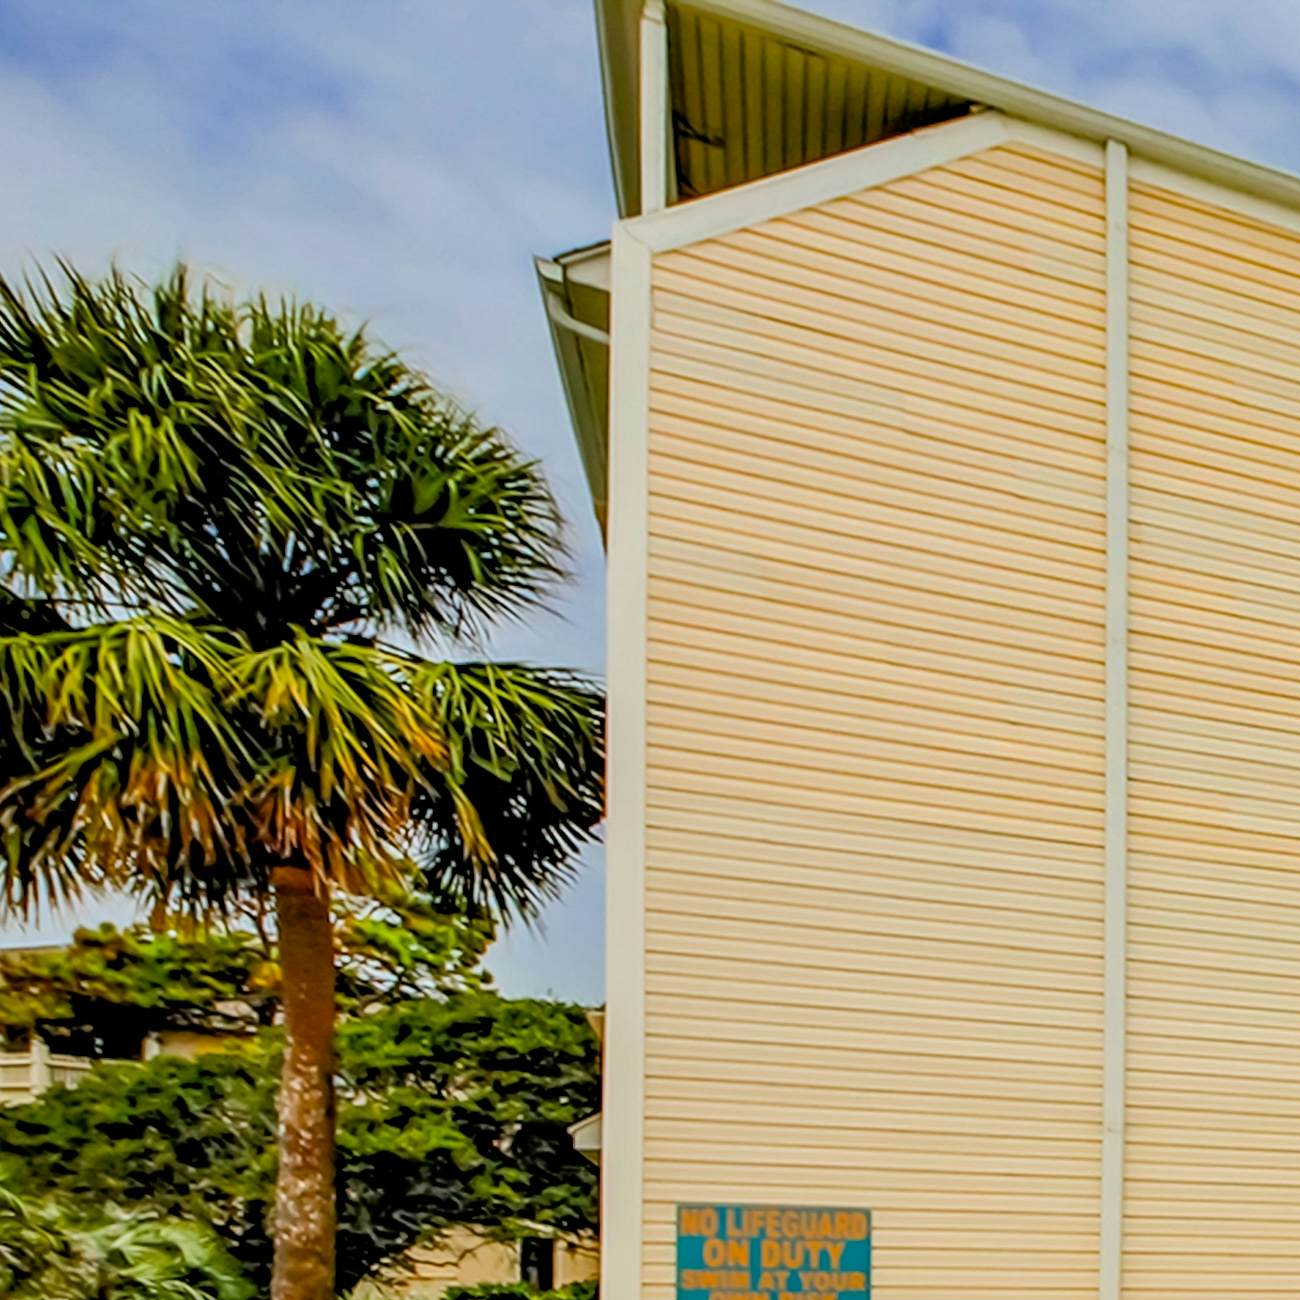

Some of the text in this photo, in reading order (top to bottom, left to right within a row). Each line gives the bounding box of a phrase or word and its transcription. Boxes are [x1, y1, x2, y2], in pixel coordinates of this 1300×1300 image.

[680, 1208, 868, 1240] NO LIFEGUARD
[703, 1238, 845, 1269] ON DUTY
[681, 1269, 865, 1290] SWIM AT YOUR
